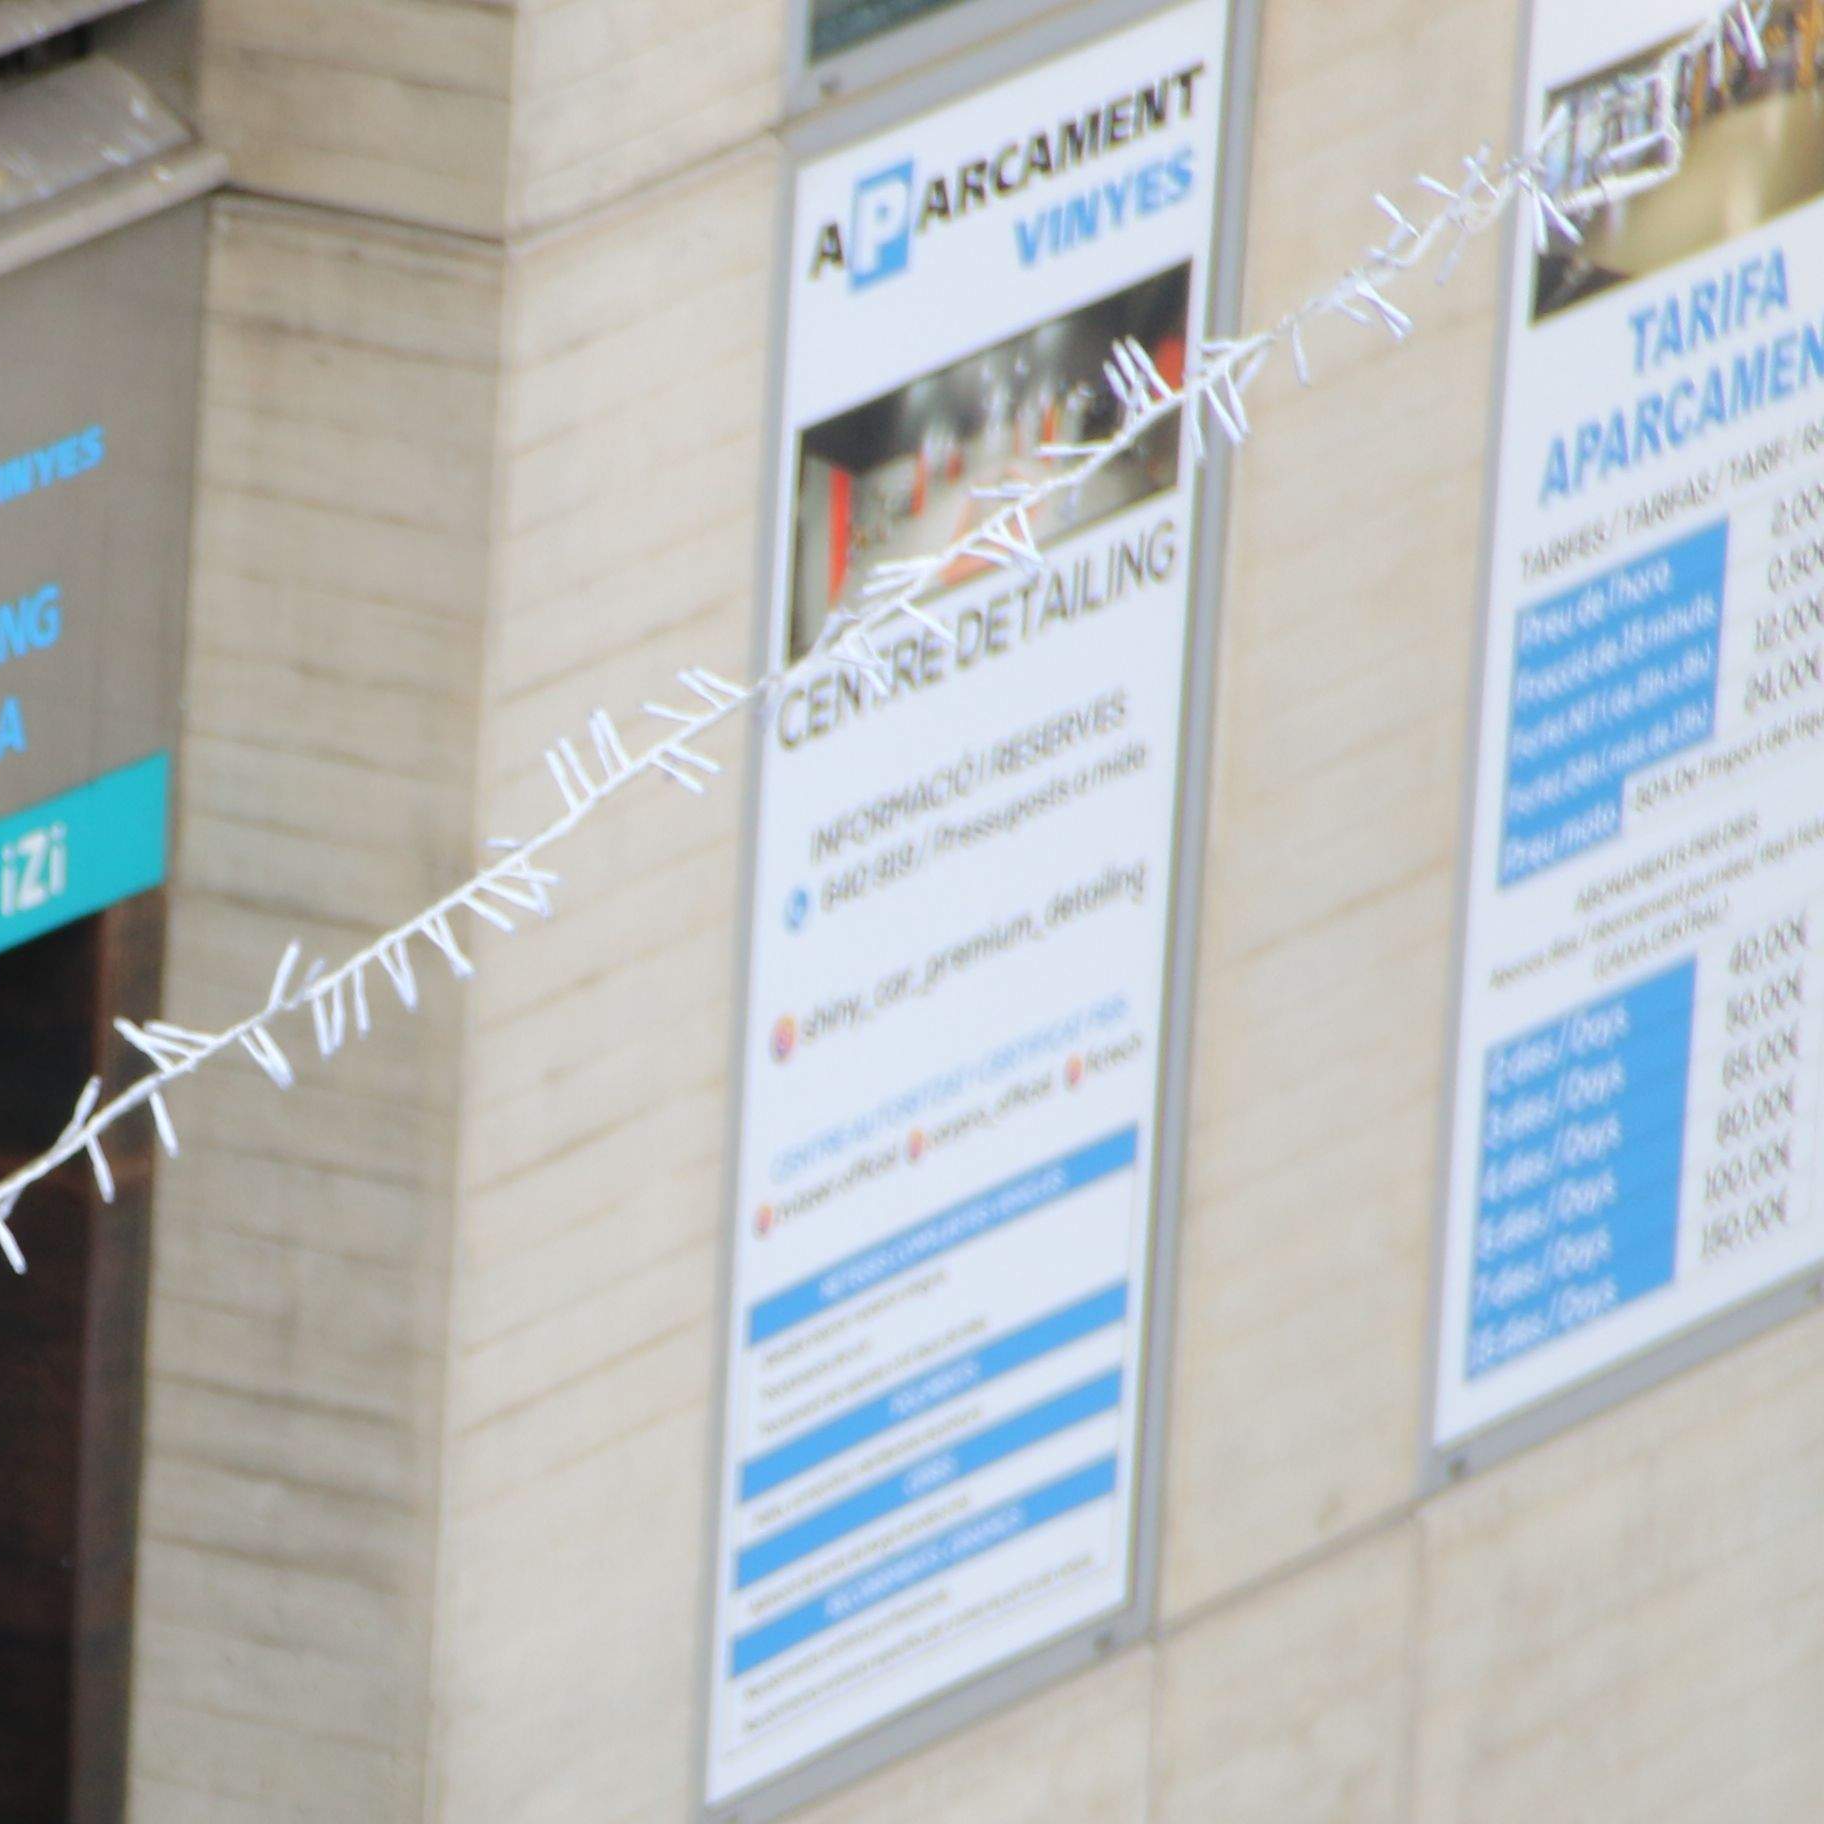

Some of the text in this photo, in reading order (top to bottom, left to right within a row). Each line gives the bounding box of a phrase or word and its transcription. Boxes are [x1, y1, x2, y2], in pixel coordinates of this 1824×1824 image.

[1014, 148, 1195, 266] VINYES
[1628, 247, 1788, 373] TARIFA
[1539, 317, 1824, 509] APARCAMEN
[955, 519, 1176, 668] DETAILING
[989, 685, 1128, 777] RESERVES
